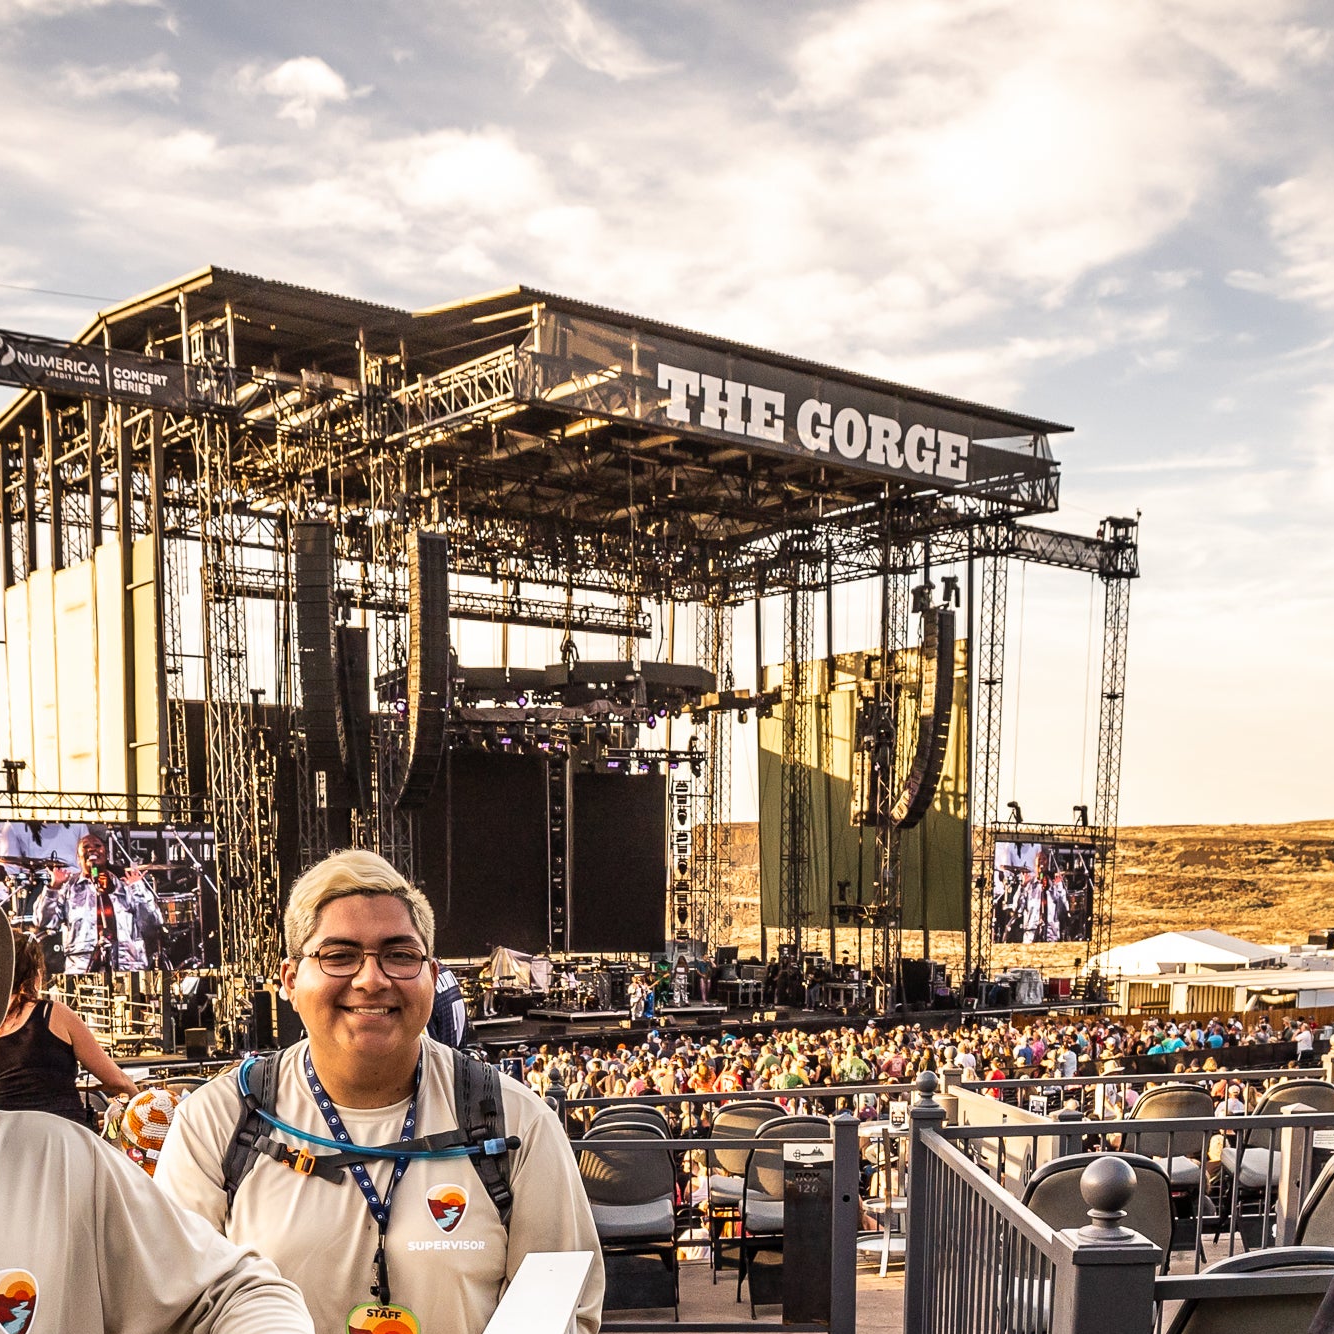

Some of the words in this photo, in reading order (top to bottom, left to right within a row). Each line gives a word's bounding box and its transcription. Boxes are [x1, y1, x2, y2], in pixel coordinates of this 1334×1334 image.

[17, 351, 100, 377] NUMERICA
[45, 369, 73, 380] CREDIT
[74, 374, 100, 385] UNION
[113, 366, 168, 387] CONCERT
[114, 379, 152, 395] SERIES
[657, 363, 785, 443] THE
[796, 398, 969, 482] GORGE
[795, 1172, 820, 1182] BOX
[798, 1184, 819, 1193] 126
[407, 1240, 486, 1252] SUPERVISOR
[366, 1308, 402, 1320] STAFF
